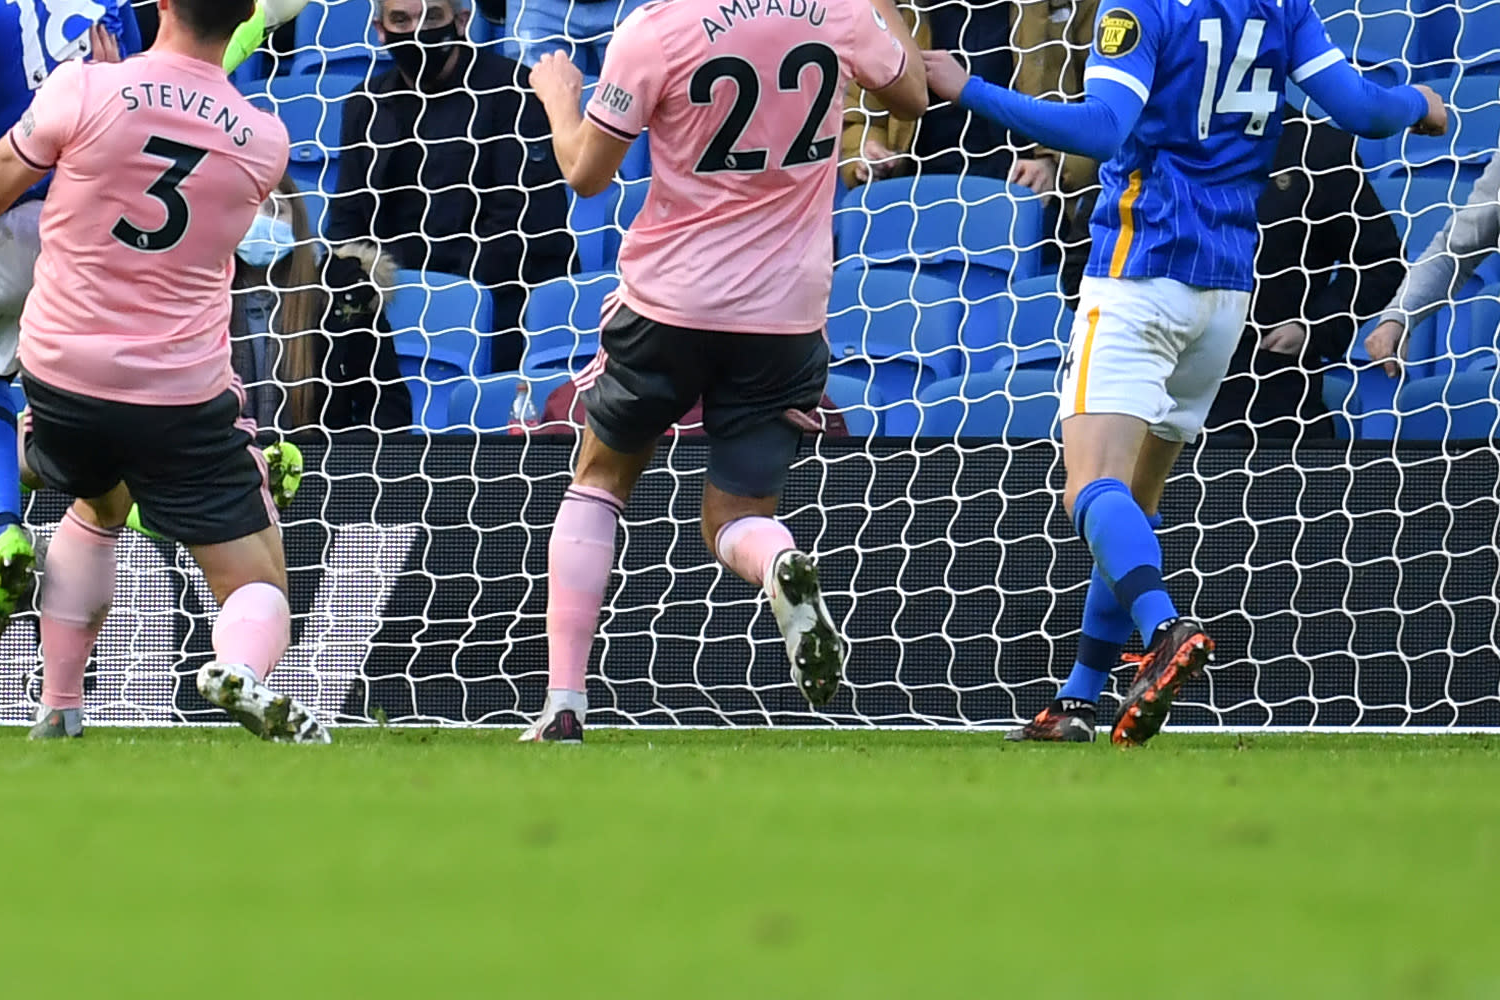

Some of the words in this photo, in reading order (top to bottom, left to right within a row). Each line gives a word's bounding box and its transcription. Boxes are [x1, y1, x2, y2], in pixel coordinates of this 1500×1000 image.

[120, 83, 254, 147] STEVENS
[688, 40, 840, 174] 22
[1198, 18, 1278, 140] 14
[109, 134, 211, 253] 3
